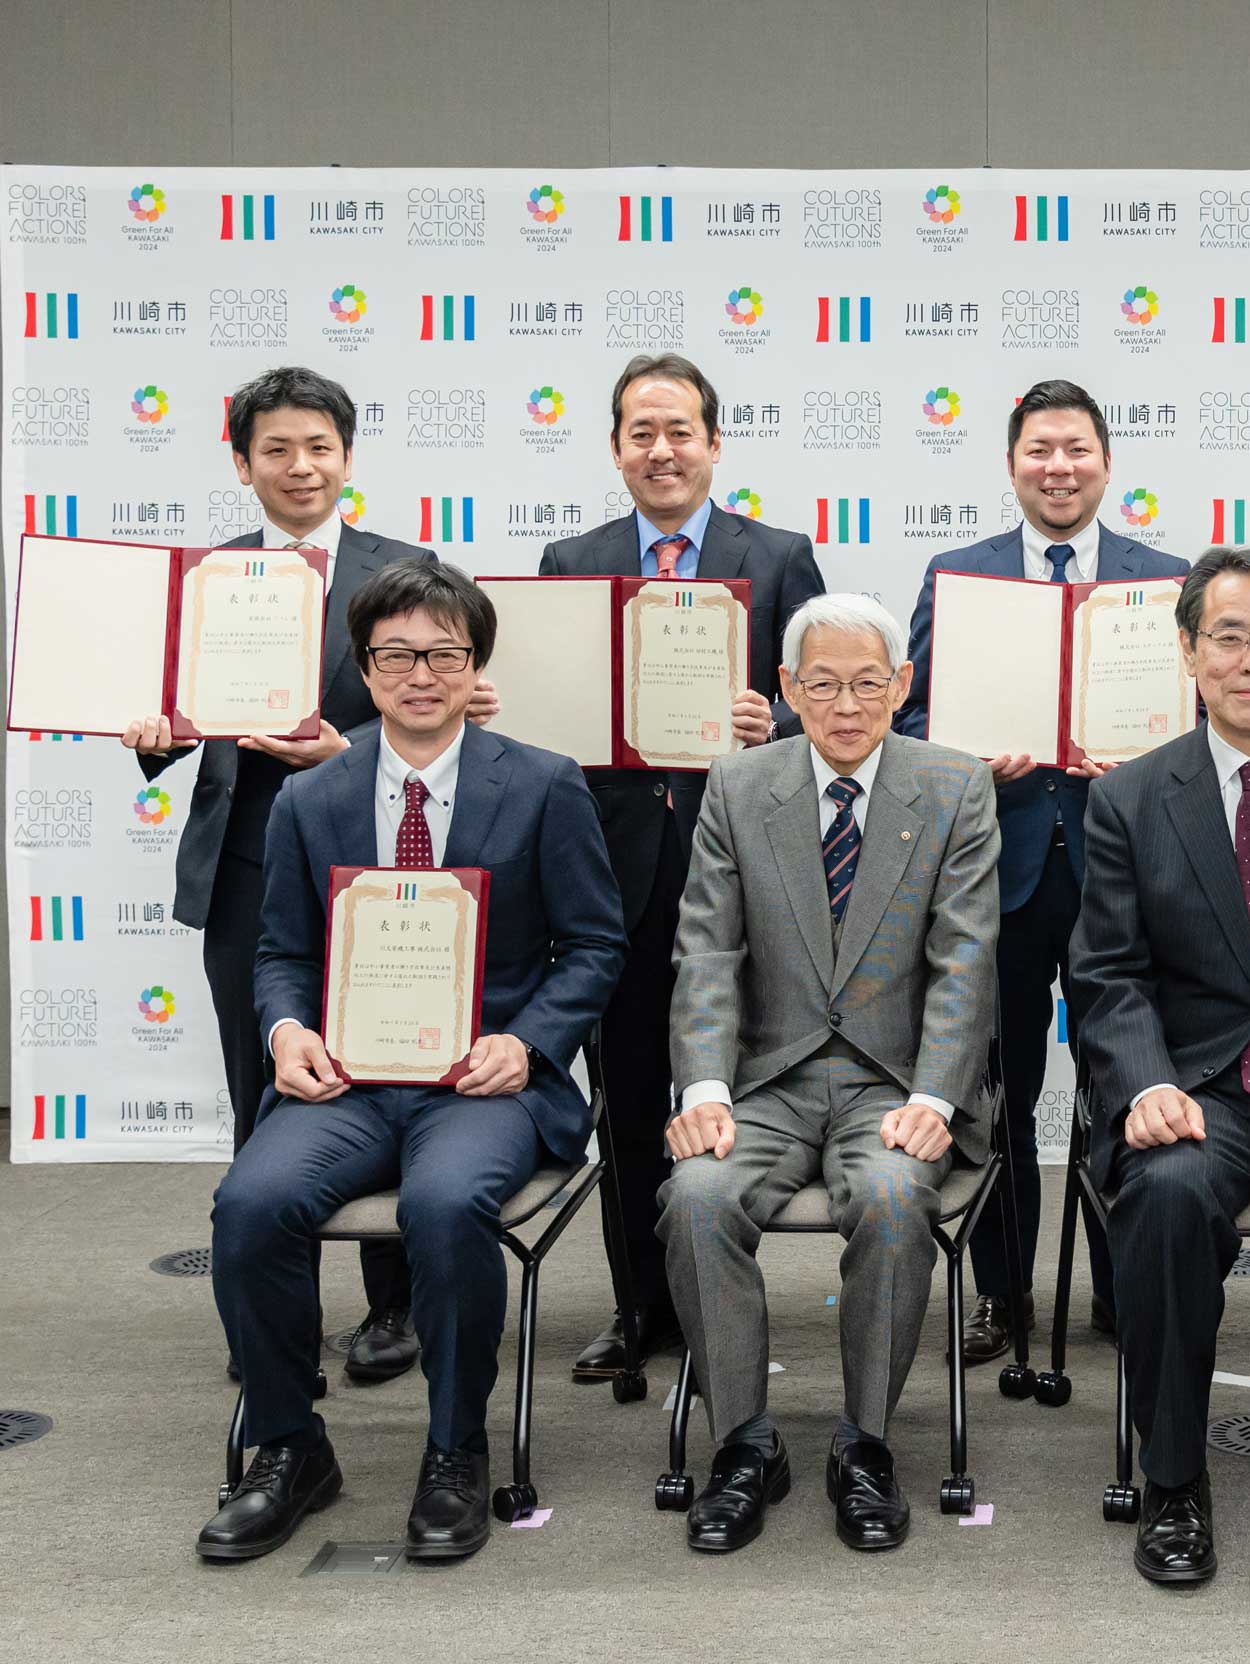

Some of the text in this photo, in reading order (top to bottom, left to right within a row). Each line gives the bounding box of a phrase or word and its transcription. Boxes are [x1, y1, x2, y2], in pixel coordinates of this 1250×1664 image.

[310, 200, 384, 222] 川崎市
[707, 202, 782, 224] 川崎市
[803, 206, 882, 223] FUTURE!
[1103, 201, 1178, 223] 川崎市
[310, 227, 384, 235] KAWASAKI CITY
[706, 229, 782, 237] KAWASAKI CITY
[804, 223, 882, 239] ACTIONS
[1102, 228, 1178, 236] KAWASAKI CITY
[804, 240, 882, 249] KAWASAKI 100th
[113, 300, 188, 322] 川崎市
[209, 305, 288, 322] FUTURE!
[509, 301, 584, 323] 川崎市
[905, 302, 980, 324] 川崎市
[1001, 306, 1080, 323] FUTURE!
[112, 327, 188, 335] KAWASAKI CITY
[210, 322, 288, 338] ACTIONS
[322, 327, 375, 336] Green For All
[508, 328, 584, 336] KAWASAKI CITY
[904, 329, 980, 337] KAWASAKI CITY
[1002, 323, 1080, 339] ACTIONS
[210, 339, 288, 348] KAWASAKI 100th
[328, 336, 370, 344] KAWASAKI
[1002, 340, 1080, 349] KAWASAKI 100th
[339, 345, 358, 353] 2024
[519, 428, 572, 437] Green For All
[758, 430, 781, 438] CITY
[915, 429, 968, 438] Green For All
[1109, 430, 1176, 438] AWASAKI CITY
[526, 438, 566, 446] KAWASAKI
[922, 438, 962, 446] KAWASAKI
[536, 446, 556, 454] 2024
[932, 447, 952, 455] 2024
[112, 502, 186, 524] 川崎市
[508, 503, 582, 525] 川崎市
[904, 504, 978, 526] 川崎市
[112, 529, 186, 537] KAWASAKI CITY
[508, 530, 582, 538] KAWASAKI CITY
[904, 531, 978, 539] KAWASAKI CITY
[15, 823, 93, 839] ACTIONS
[126, 828, 179, 837] Green For All
[132, 838, 174, 846] KAWASAKI
[143, 846, 162, 854] 2024
[117, 928, 191, 936] KAWASAKI CITY
[120, 1100, 194, 1122] 川崎市
[120, 1127, 194, 1135] KAWASAKI CITY
